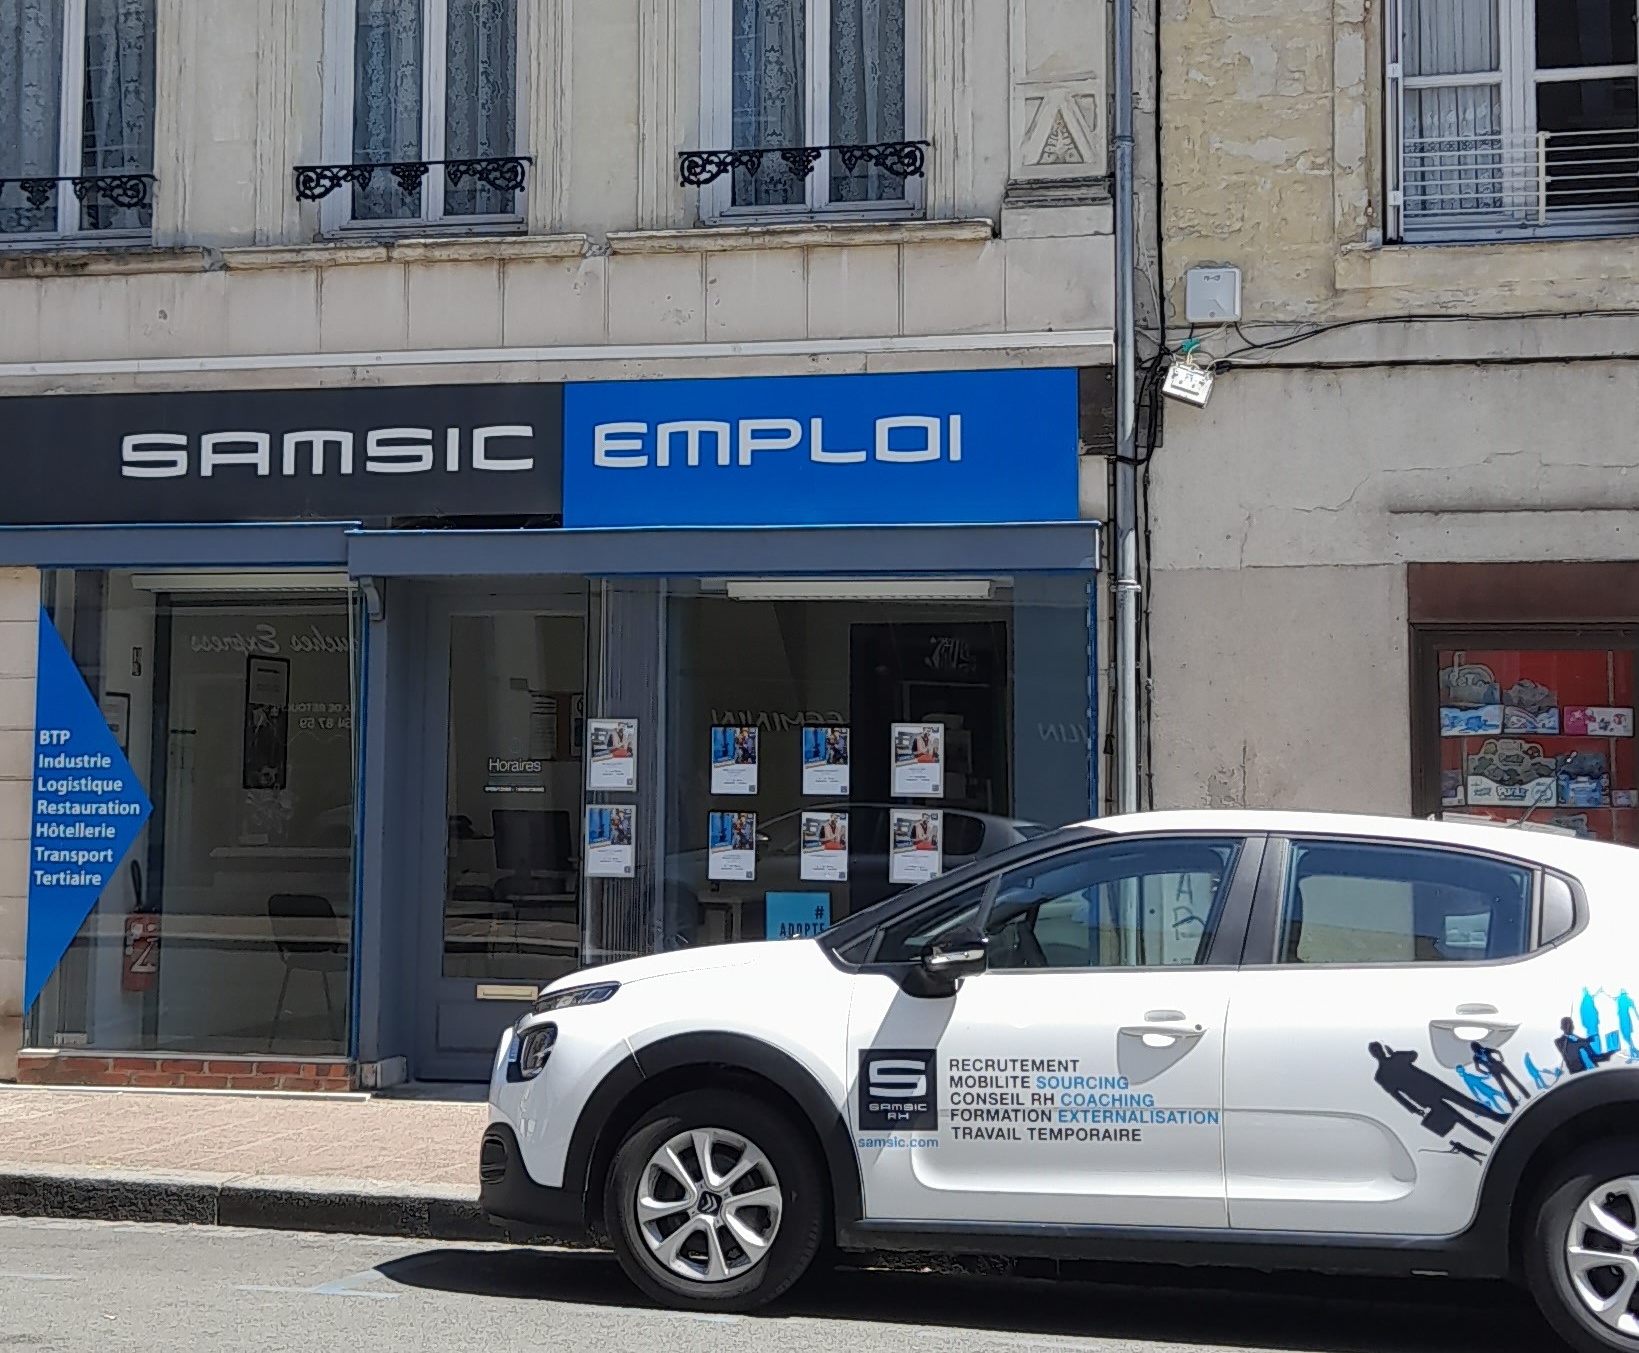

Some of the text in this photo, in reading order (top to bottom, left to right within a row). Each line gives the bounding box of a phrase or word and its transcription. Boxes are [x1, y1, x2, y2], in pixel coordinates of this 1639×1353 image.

[121, 414, 963, 478] SAMSIC EMPLOI
[39, 730, 71, 745] BTP
[38, 753, 112, 768] Industrie
[488, 758, 542, 772] Horaires
[37, 776, 123, 795] Logistique
[36, 799, 140, 815] Restauration
[35, 822, 116, 838] Hôtellerie
[34, 846, 113, 865] Transport
[34, 870, 102, 885] Tertiaire
[949, 1058, 1080, 1073] RECRUTEMENT
[949, 1075, 1129, 1091] MOBILITE SOURCING
[868, 1103, 928, 1112] SAMSIC
[950, 1092, 1155, 1108] CONSEIL RH COACHING
[887, 1112, 910, 1121] RH
[950, 1109, 1219, 1125] FORMATION EXTERNALISATION
[951, 1126, 1143, 1142] TRAVAIL TEMPORAIRE
[857, 1136, 939, 1149] samsic.com
